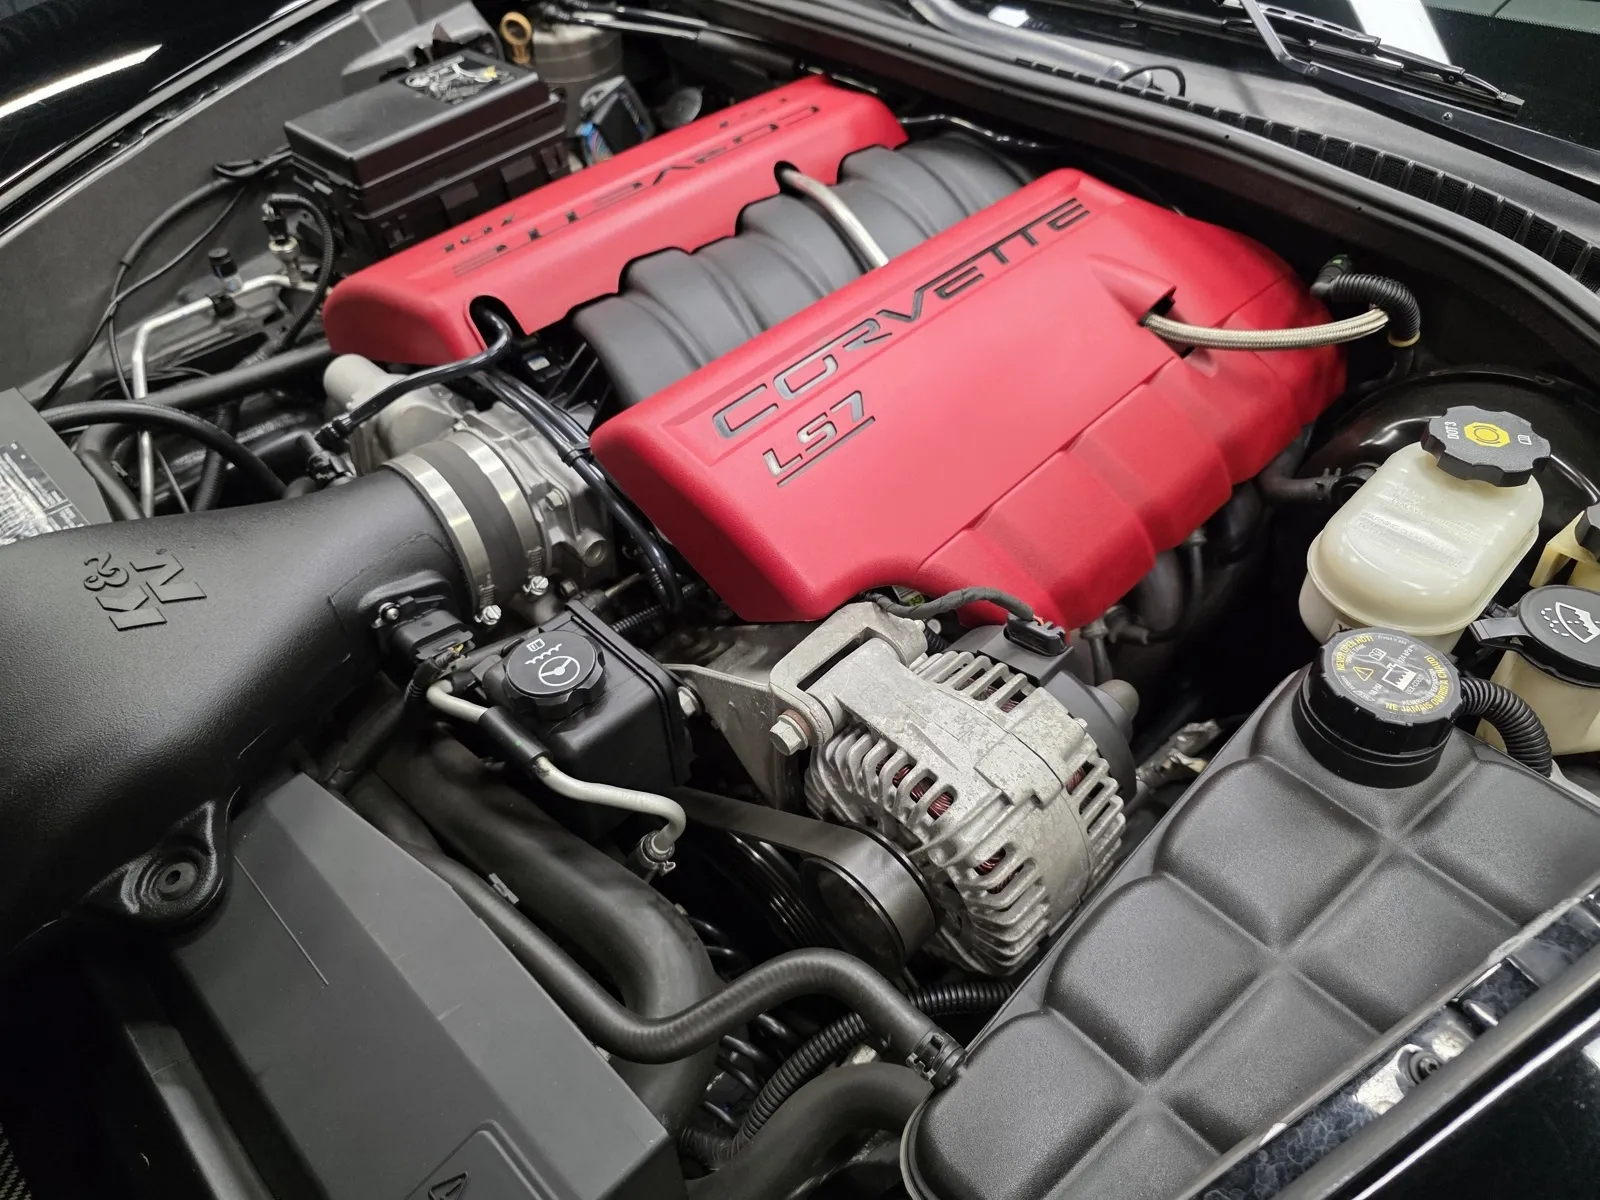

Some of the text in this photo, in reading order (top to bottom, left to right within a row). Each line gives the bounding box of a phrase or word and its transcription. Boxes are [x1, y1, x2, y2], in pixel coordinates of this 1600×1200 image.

[711, 198, 1091, 439] CORVETTE
[762, 390, 866, 478] LS7
[1445, 426, 1460, 440] DOT
[1335, 635, 1374, 671] NEVER OPEN HOT!
[1385, 702, 1399, 711] NE
[1401, 701, 1434, 712] JAMAIS
[1424, 654, 1448, 679] CHAUD!
